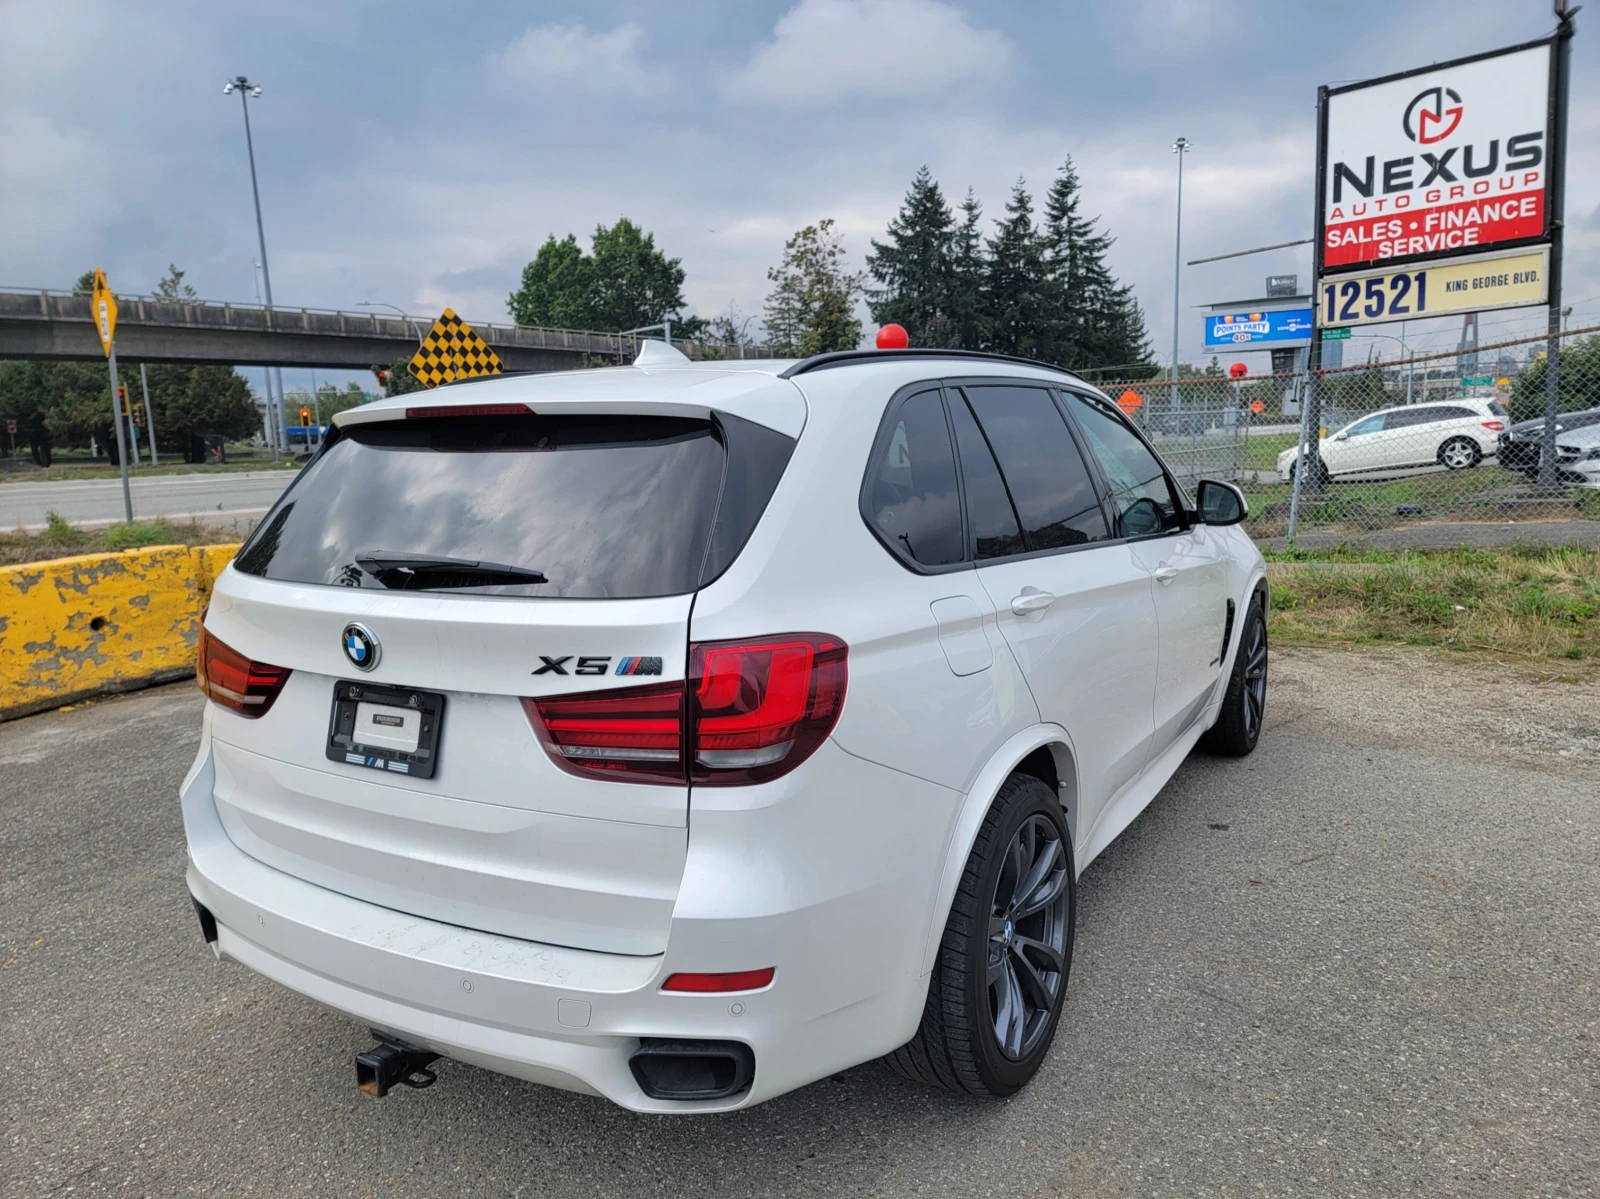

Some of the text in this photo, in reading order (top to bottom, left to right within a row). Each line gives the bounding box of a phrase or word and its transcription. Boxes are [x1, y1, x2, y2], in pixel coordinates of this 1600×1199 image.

[1333, 131, 1544, 204] NEXUS
[1330, 172, 1540, 220] AUTO GROUP
[1327, 197, 1537, 248] SALES FINANCE
[1378, 227, 1479, 259] SERVICE
[1324, 271, 1427, 322] 12521
[1445, 270, 1540, 293] KING GEORGE BLVD.
[1216, 322, 1267, 335] POINTS PARTY
[530, 655, 662, 676] X5 M
